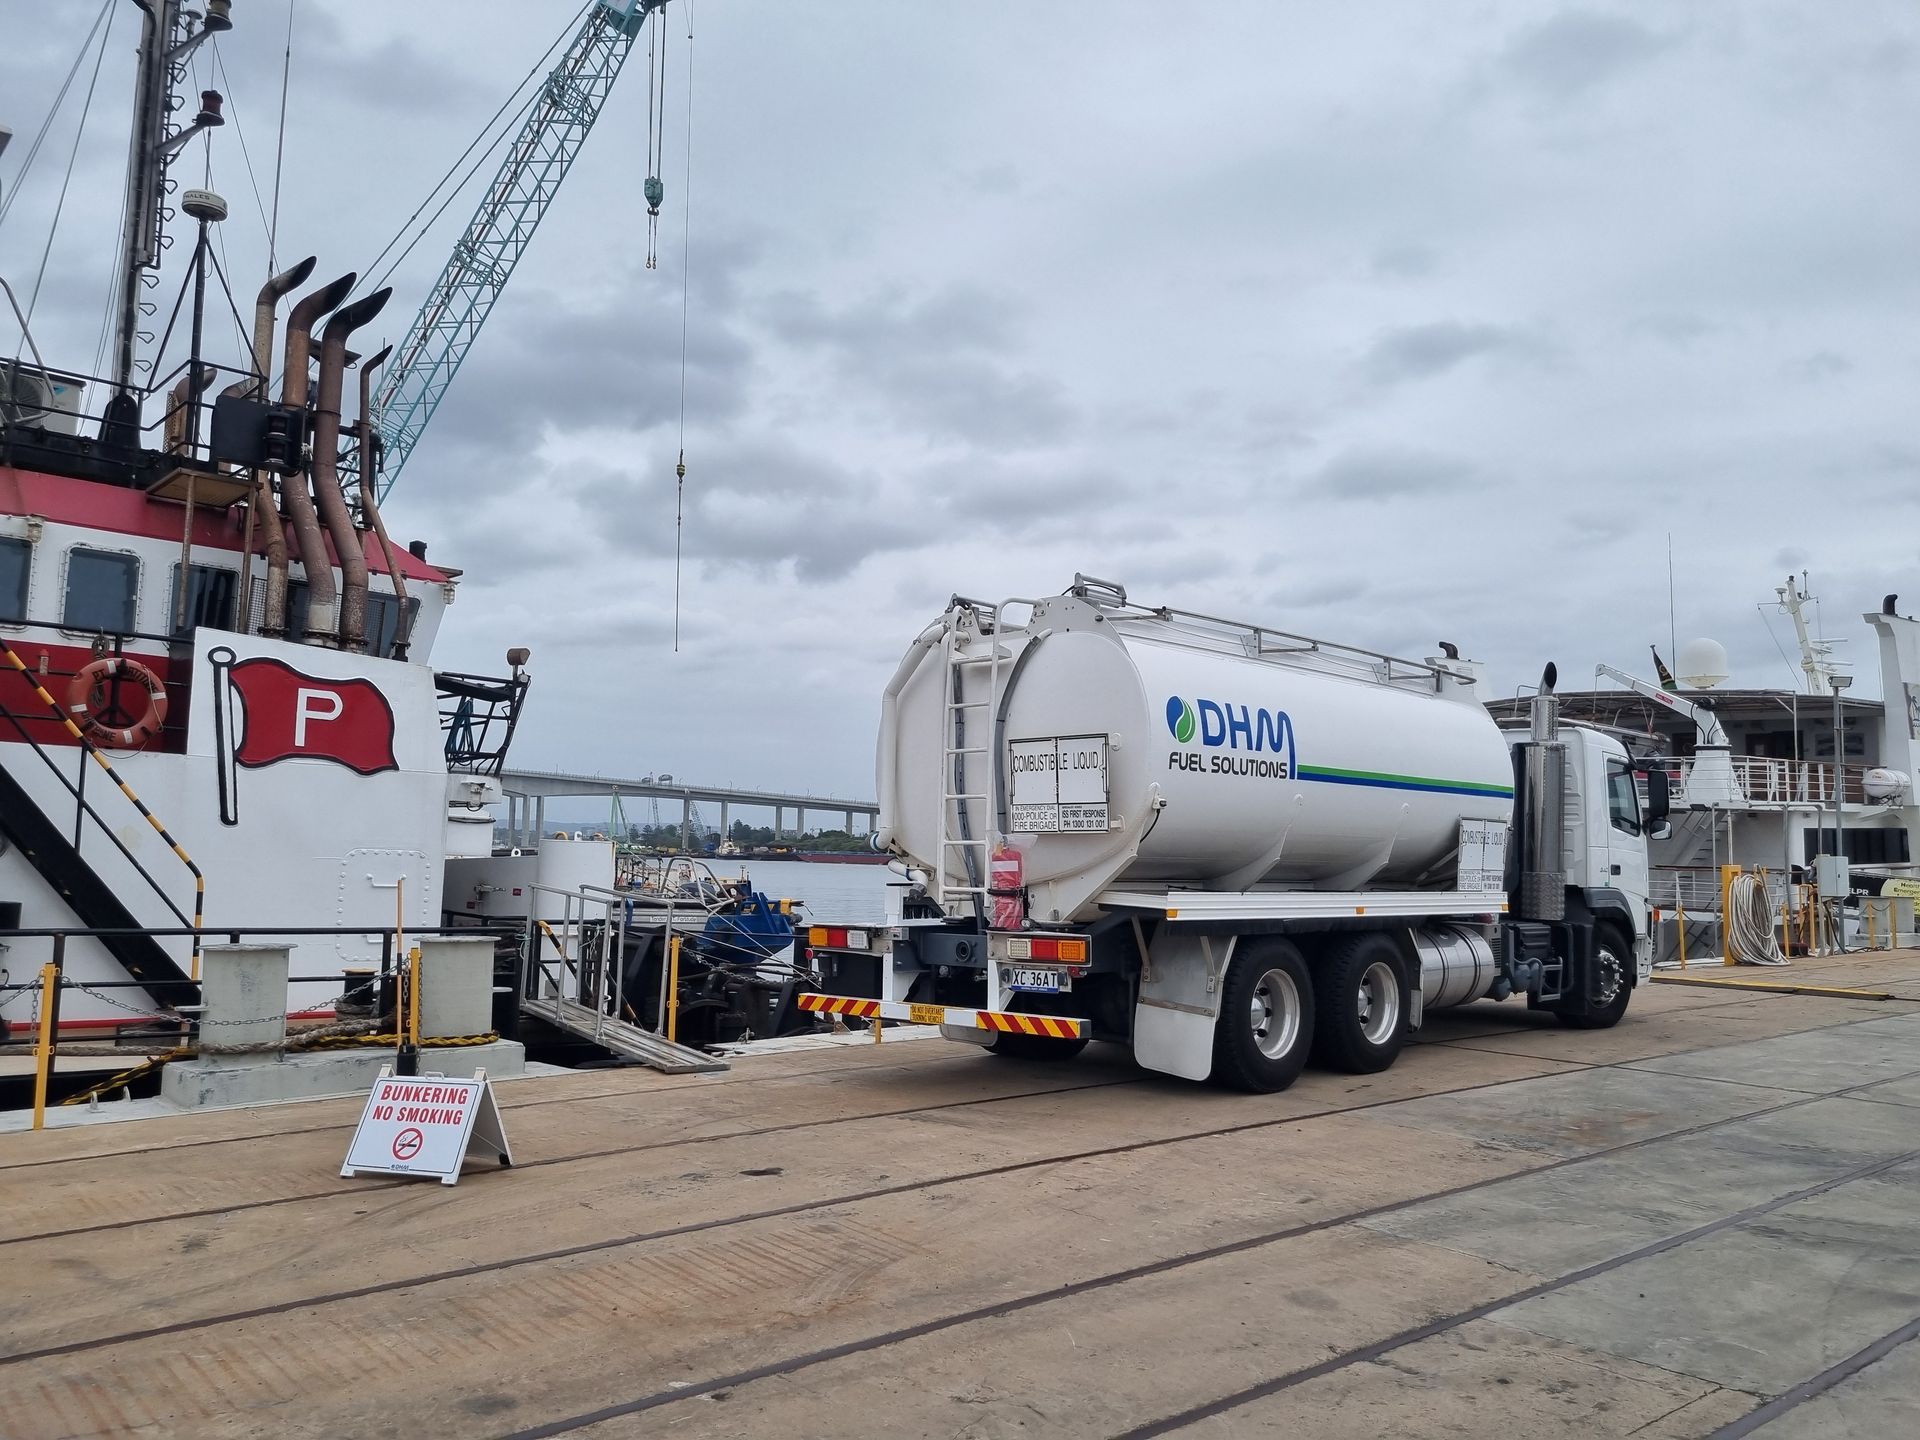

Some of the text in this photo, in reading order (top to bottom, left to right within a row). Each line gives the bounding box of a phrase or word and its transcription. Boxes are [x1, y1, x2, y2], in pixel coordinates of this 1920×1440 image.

[294, 687, 344, 747] P
[1197, 698, 1296, 780] DHM
[1013, 751, 1099, 773] COMBUSTIBLE LIQUID
[1168, 751, 1288, 779] FUEL SOLUTIONS
[1070, 809, 1082, 818] FIRST
[1083, 809, 1106, 818] RESPONSE
[1015, 820, 1057, 830] FIRE BRIGADE
[1063, 820, 1071, 828] PH
[1013, 970, 1057, 987] XC 36AT
[381, 1084, 469, 1105] BUNKERING
[373, 1105, 463, 1125] NO SMOKING
